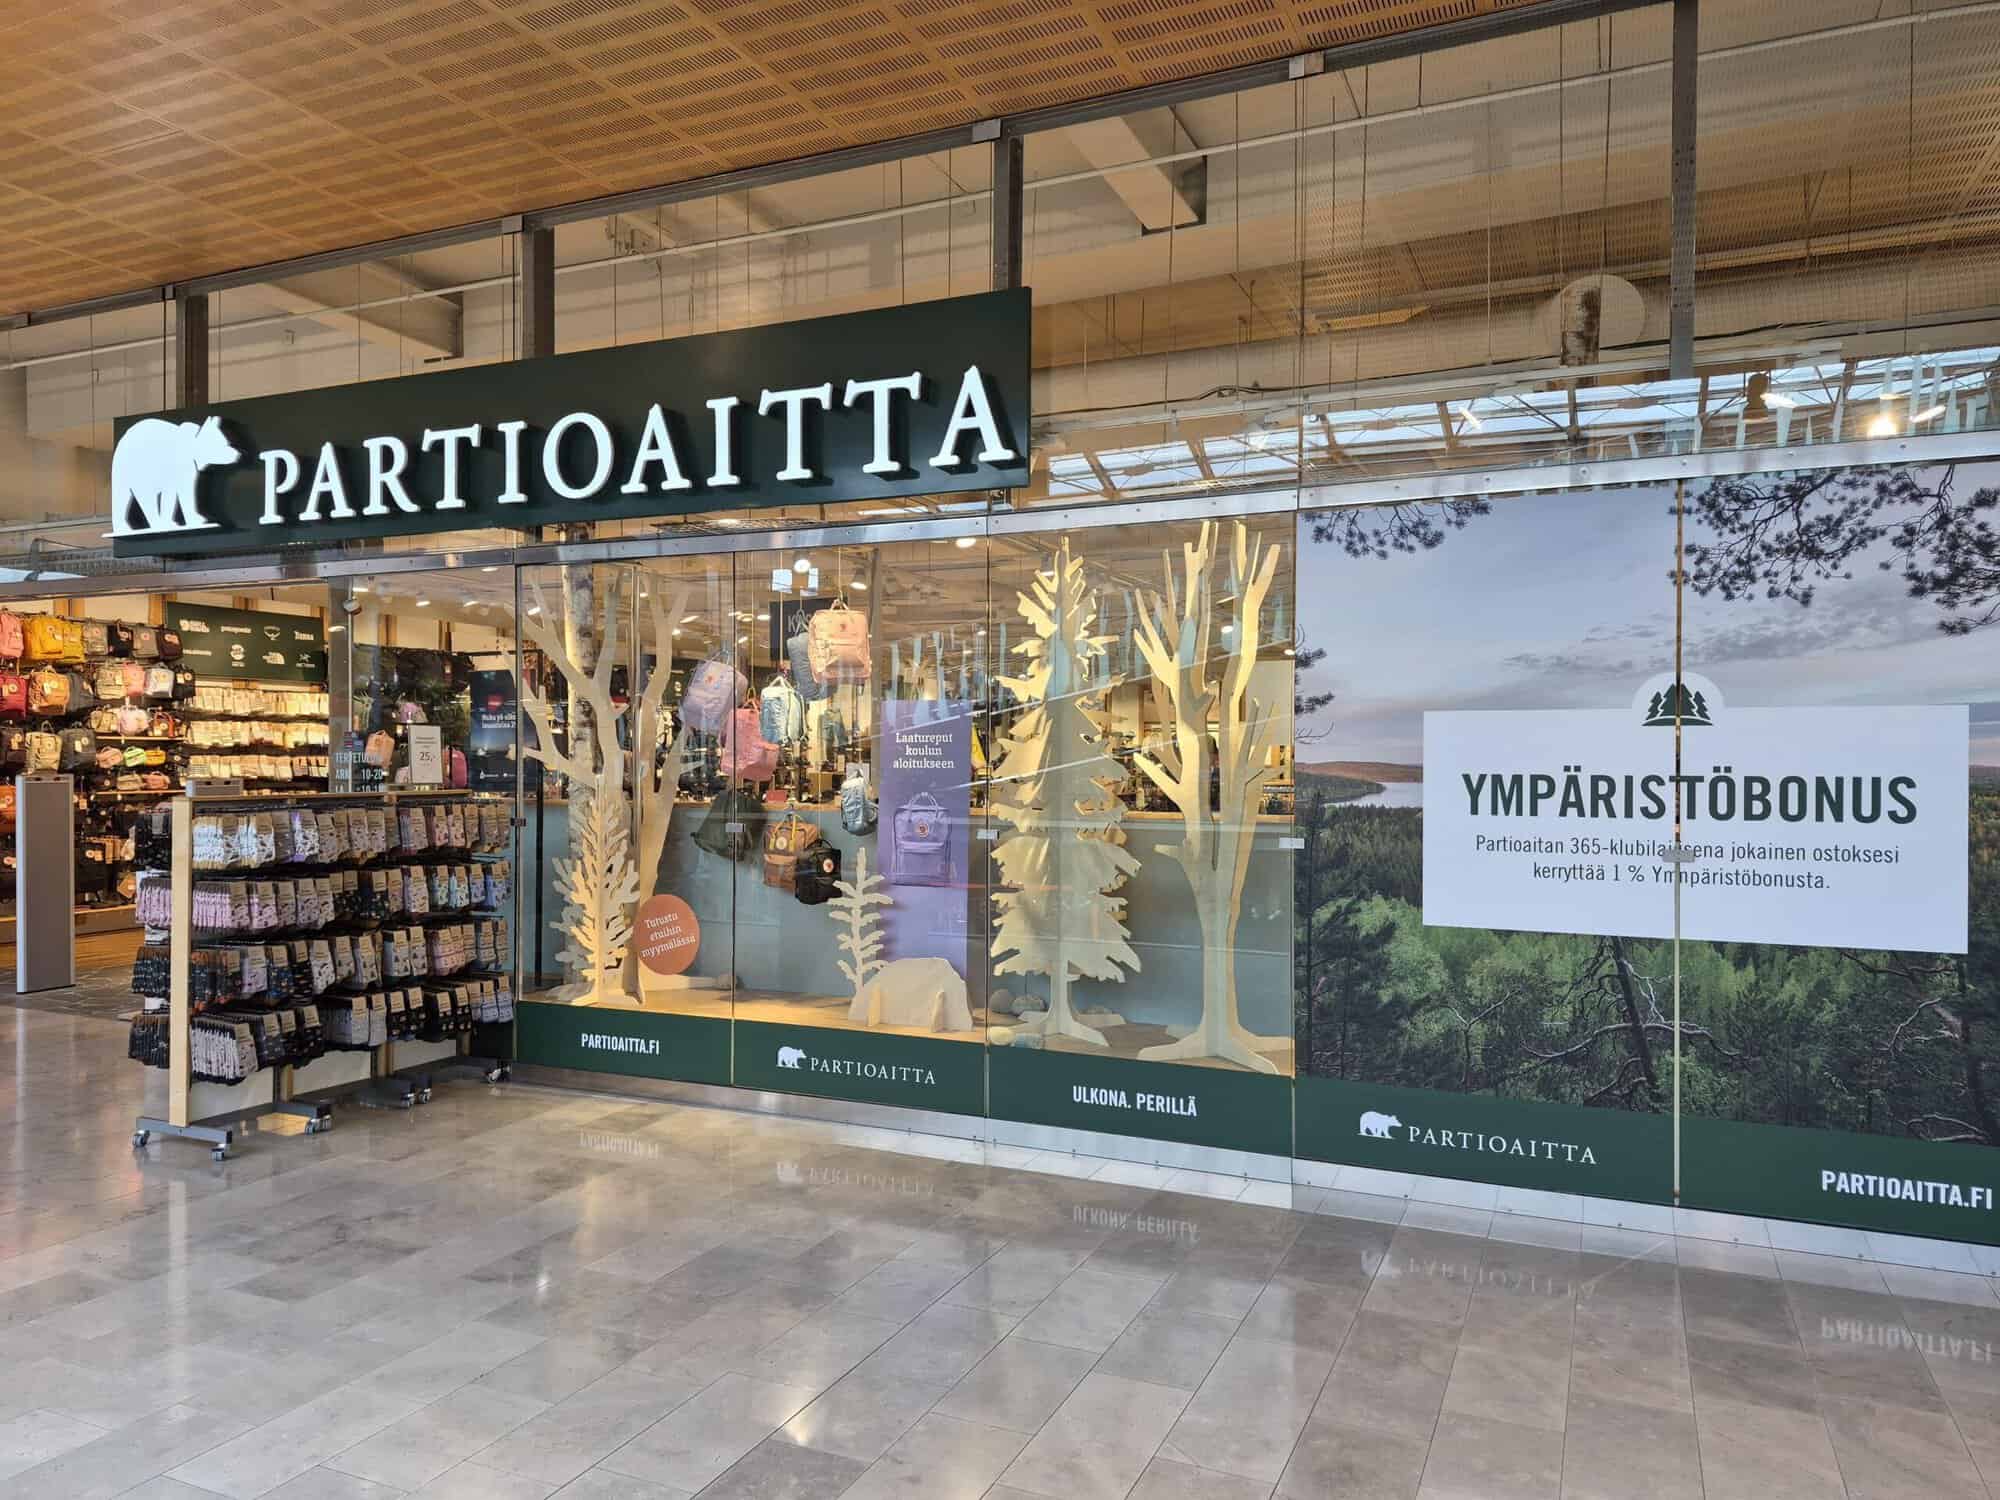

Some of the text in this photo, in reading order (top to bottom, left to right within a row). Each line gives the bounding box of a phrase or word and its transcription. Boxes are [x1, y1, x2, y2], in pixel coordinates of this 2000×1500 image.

[258, 364, 1018, 526] PARTIOAITTA
[895, 732, 953, 745] Laatureput
[905, 744, 942, 756] koulun
[893, 757, 954, 769] aloitukseen
[1461, 766, 1918, 824] YMPÄRISTÖBONUS
[1476, 835, 1564, 854] Partioaitan
[1730, 841, 1806, 863] jokainen
[1812, 845, 1899, 864] ostoksesi
[1533, 862, 1830, 889] kerryttää 1 % Ympäristöbonusta.
[581, 1032, 660, 1055] PARTIOAITTA.FI
[810, 1057, 936, 1085] PARTIOAITTA
[1072, 1085, 1197, 1117] ULKONA. PERILLÄ
[1408, 1125, 1597, 1165] PARTIOAITTA
[1821, 1169, 1993, 1210] PARTIOAITTA.FI
